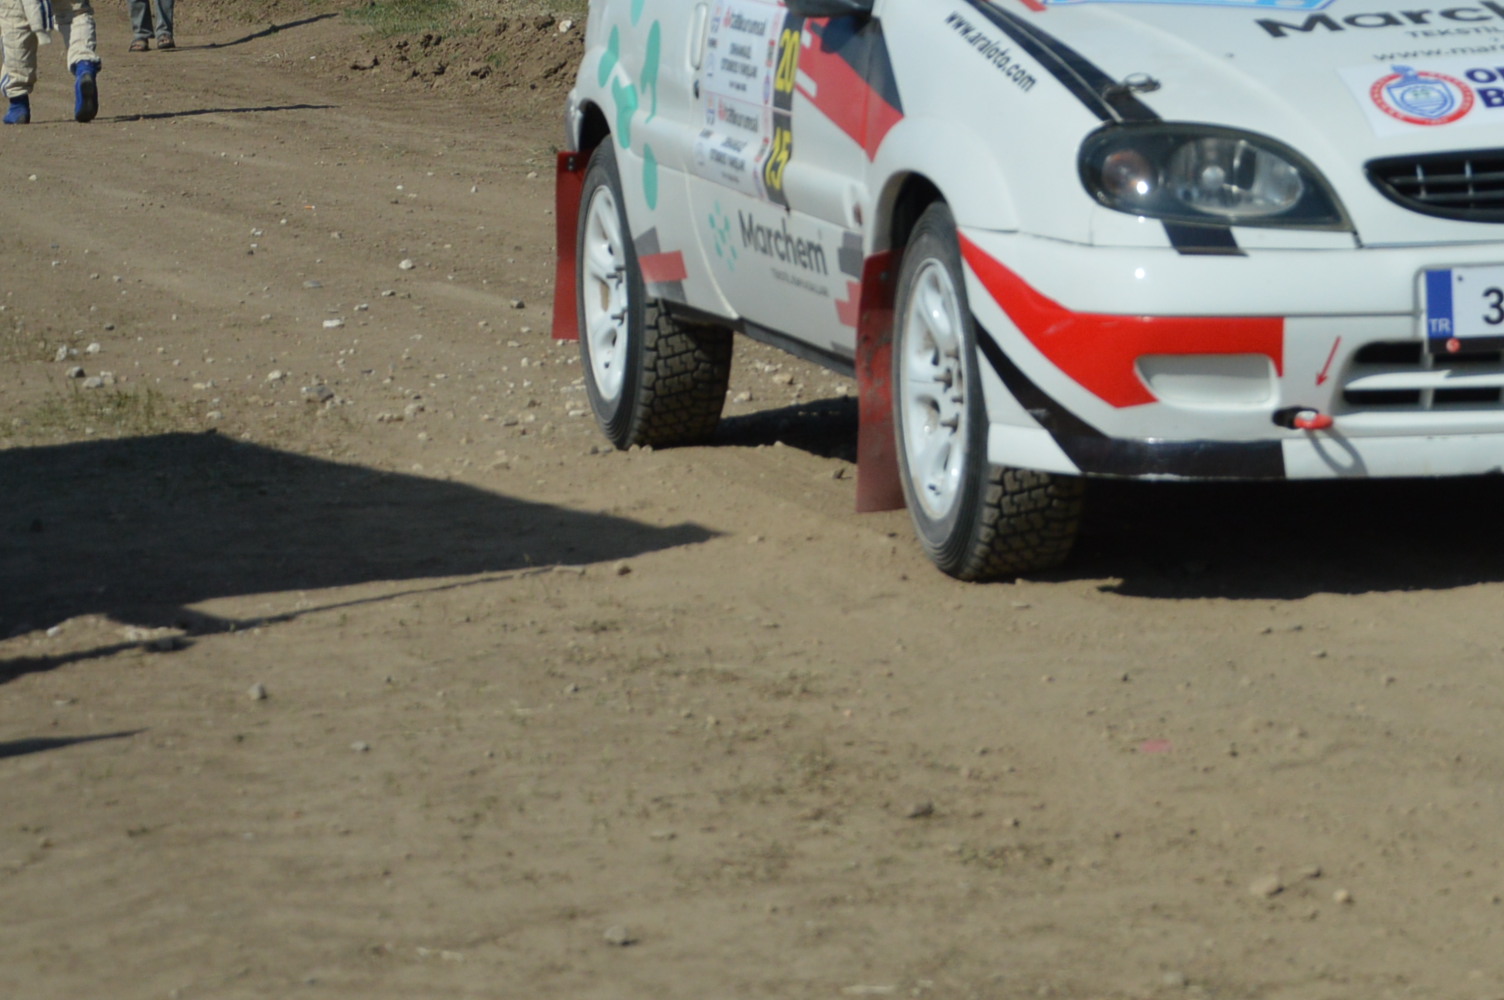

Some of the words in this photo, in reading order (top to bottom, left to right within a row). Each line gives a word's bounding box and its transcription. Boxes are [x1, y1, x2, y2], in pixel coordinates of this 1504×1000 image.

[774, 28, 801, 94] 20
[944, 10, 1038, 93] www.araloto.com
[765, 126, 792, 191] 15
[738, 208, 829, 276] Marchem
[1429, 318, 1451, 333] TR
